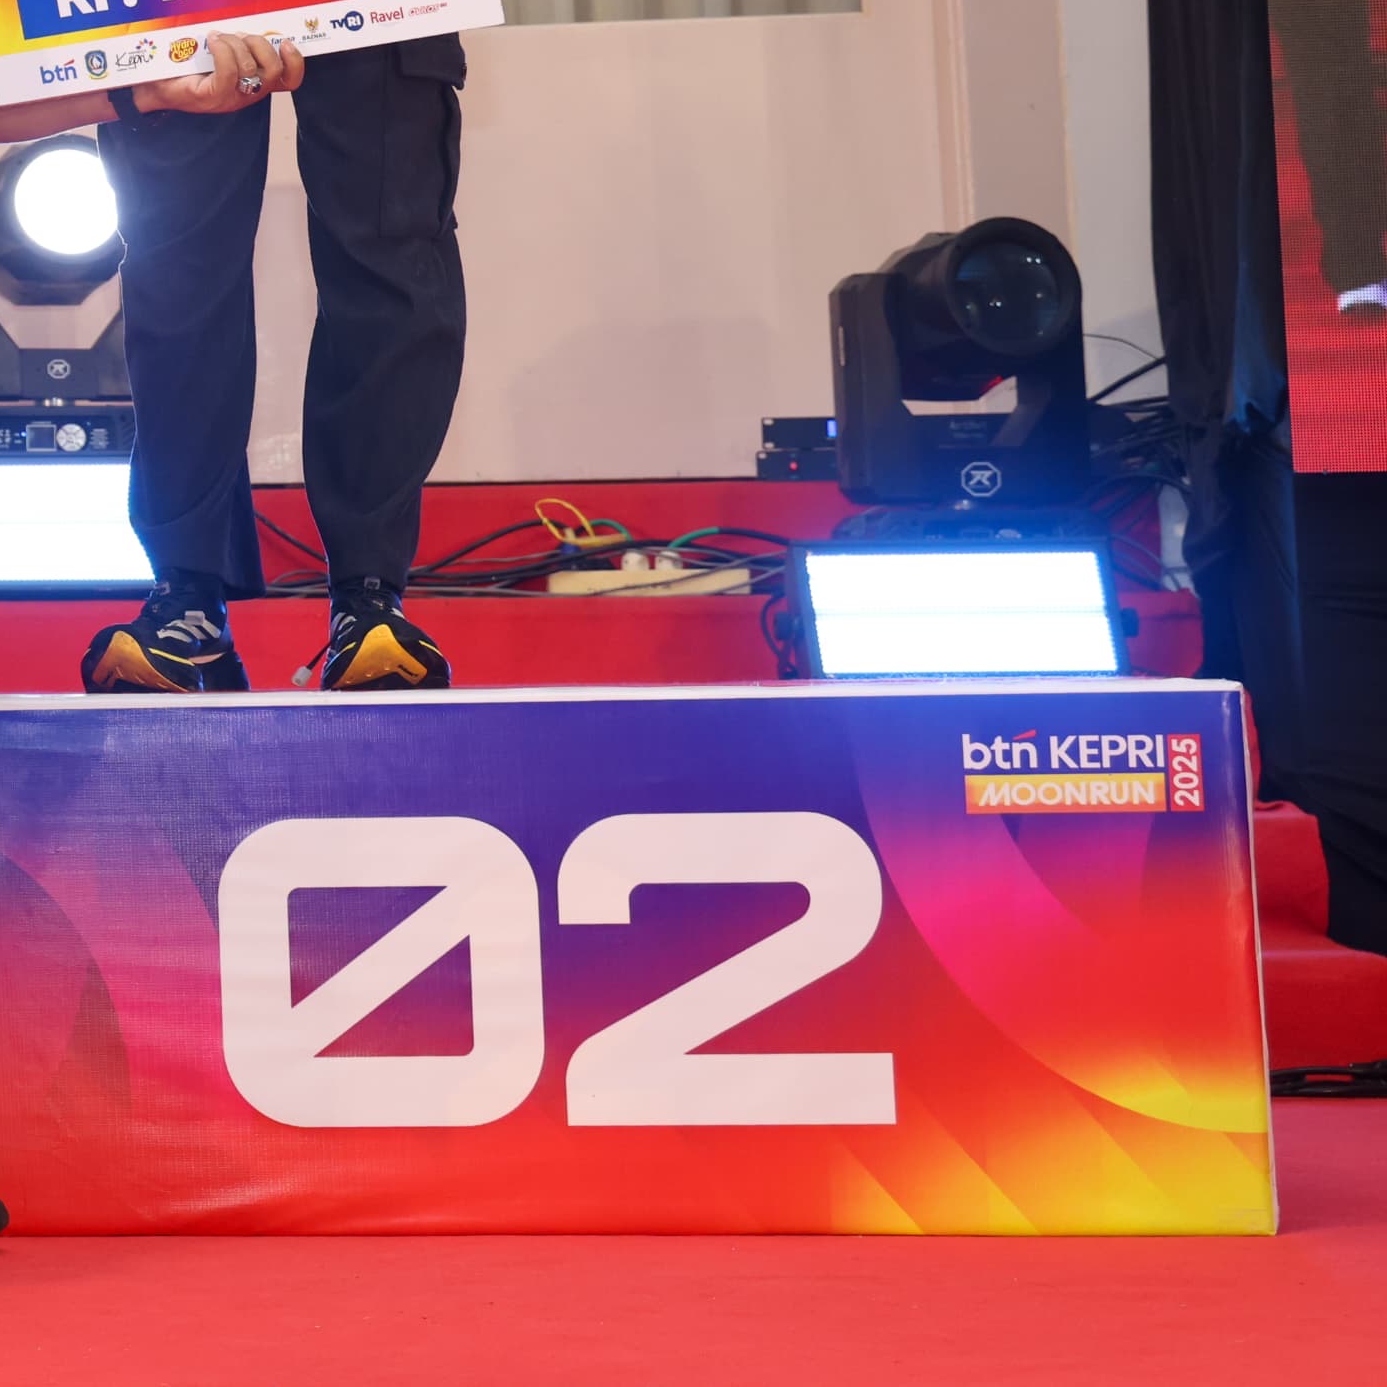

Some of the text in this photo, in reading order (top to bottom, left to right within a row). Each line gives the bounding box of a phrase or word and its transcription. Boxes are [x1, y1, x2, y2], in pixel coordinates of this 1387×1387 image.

[370, 7, 404, 24] Ravel
[170, 37, 197, 55] Hydro
[171, 46, 195, 62] Coco
[40, 59, 77, 84] btn
[962, 729, 1165, 770] btn KEPRI
[1171, 738, 1201, 807] 2025
[979, 780, 1156, 807] MOONRUN
[218, 811, 897, 1128] 02
